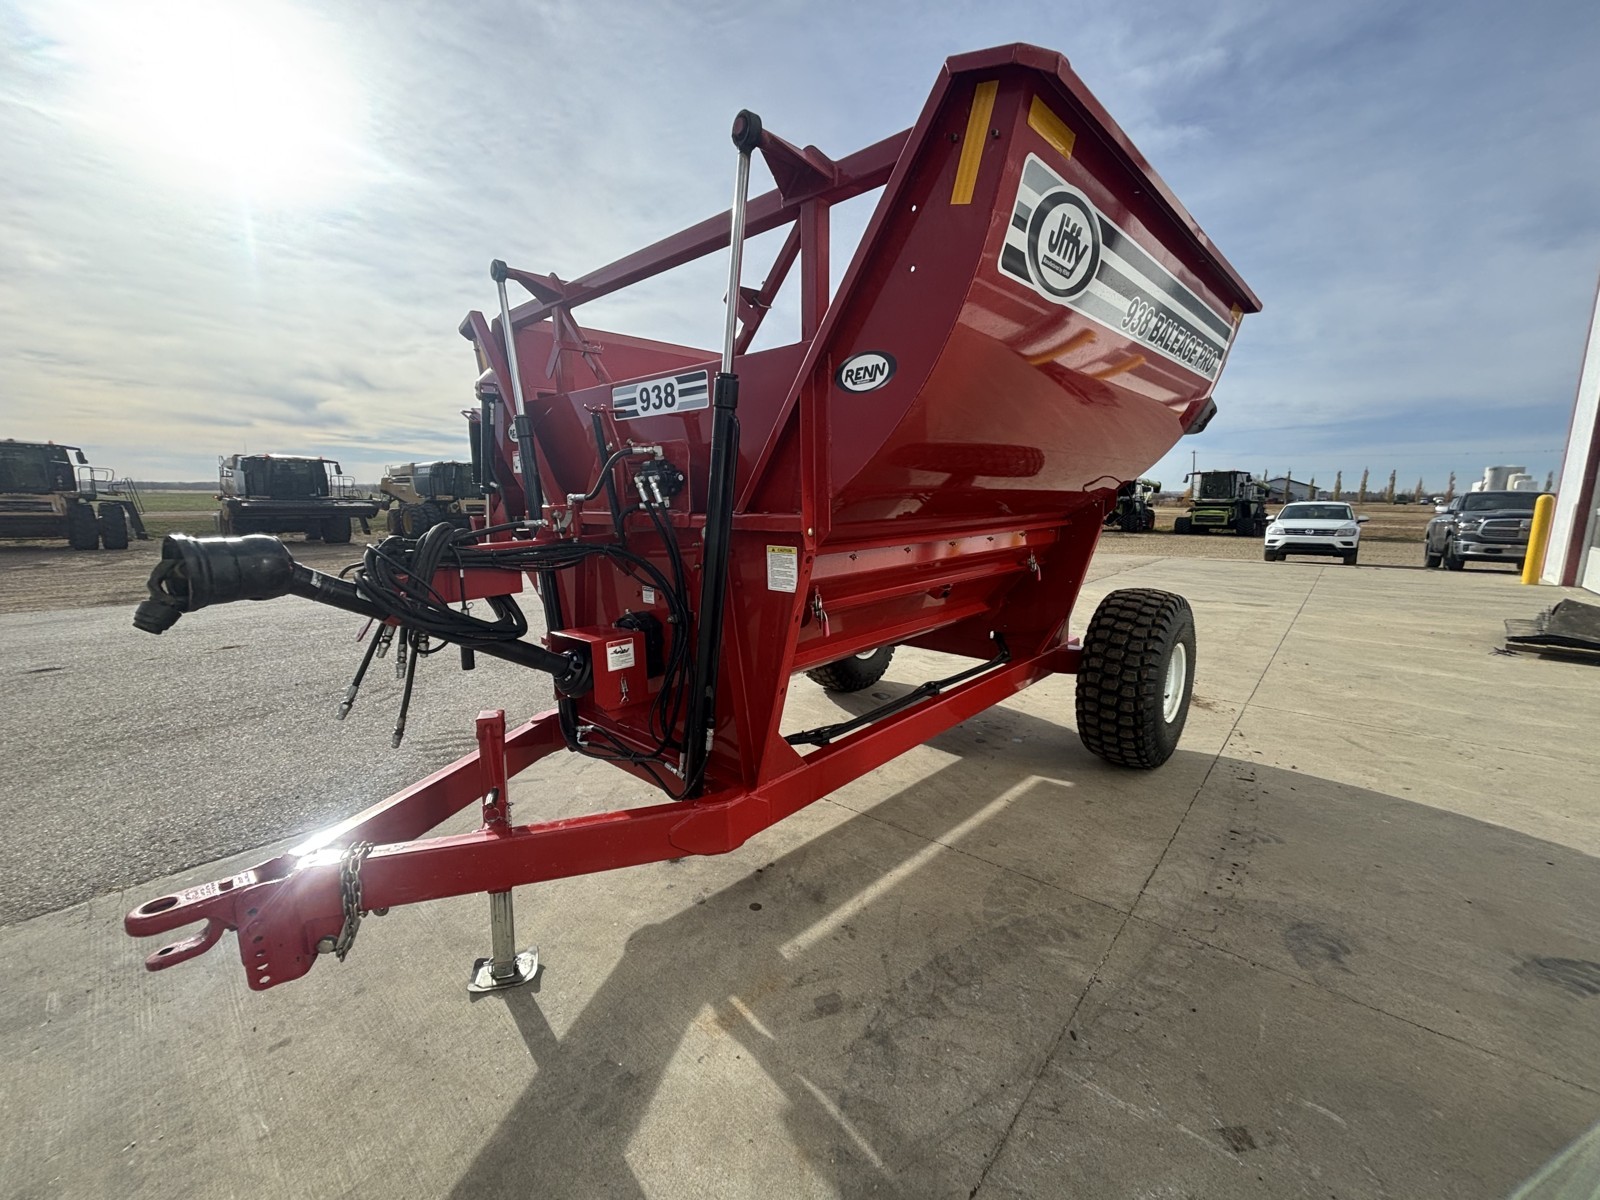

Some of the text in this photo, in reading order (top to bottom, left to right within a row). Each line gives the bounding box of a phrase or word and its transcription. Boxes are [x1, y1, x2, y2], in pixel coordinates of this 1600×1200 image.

[1121, 296, 1218, 374] 938 BALEAGE PRO
[844, 361, 886, 386] RENN
[639, 382, 676, 412] 938
